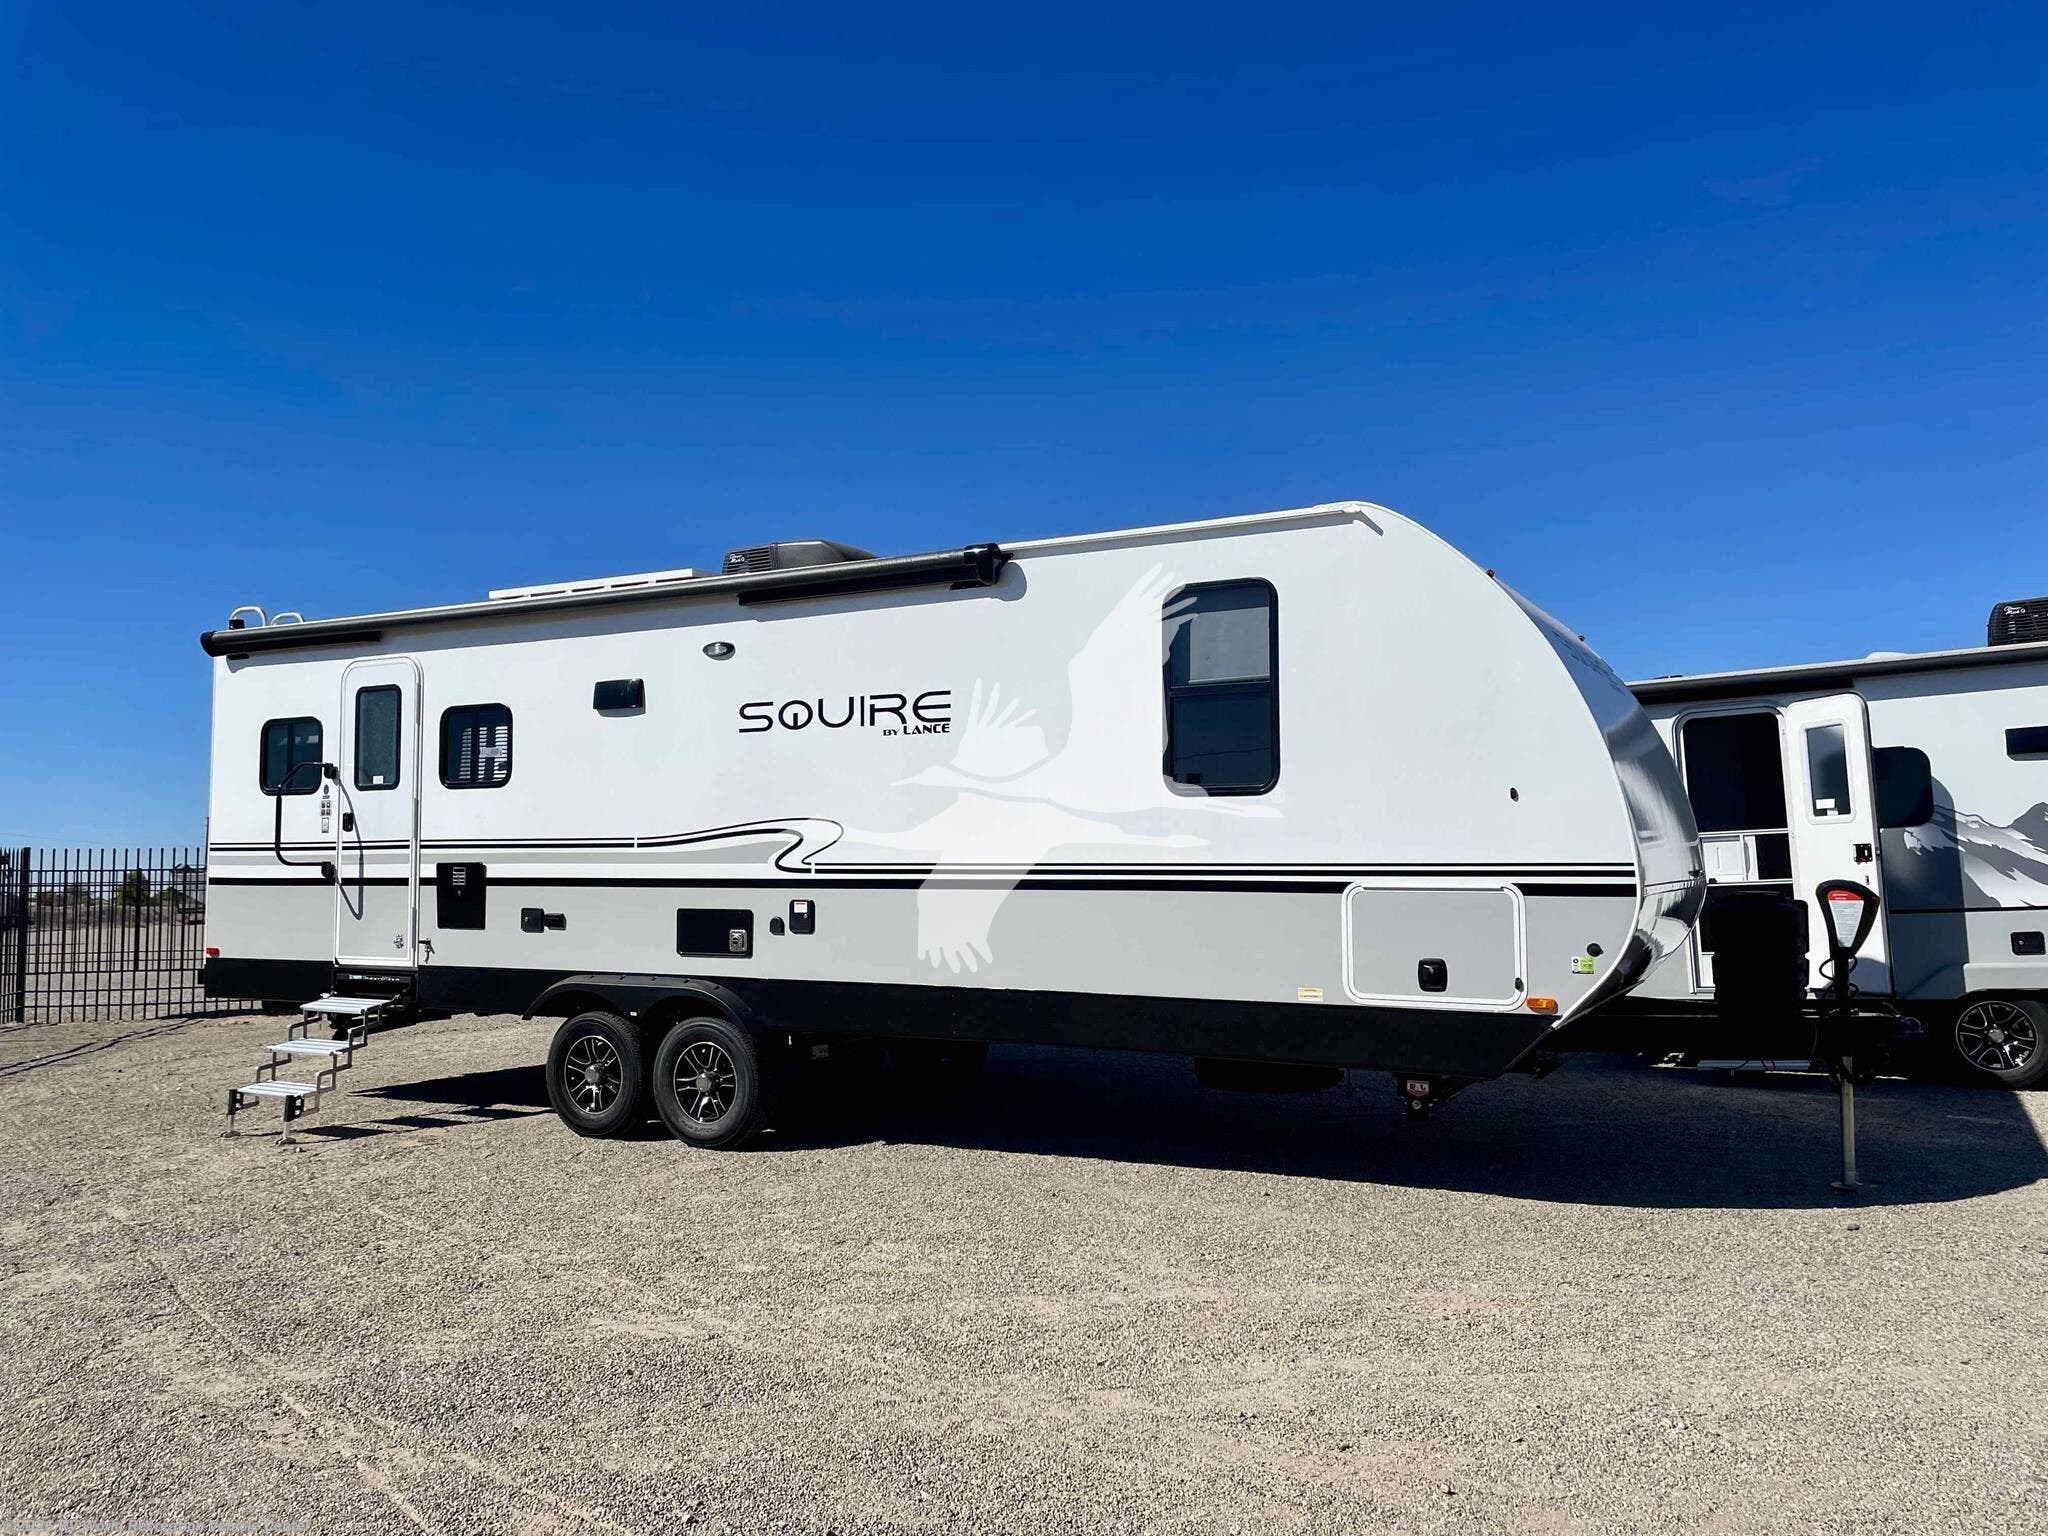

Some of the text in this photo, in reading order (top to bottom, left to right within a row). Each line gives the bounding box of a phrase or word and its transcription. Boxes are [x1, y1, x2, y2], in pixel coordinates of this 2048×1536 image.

[738, 690, 952, 734] SQUIRE
[883, 723, 951, 737] BY LANCE
